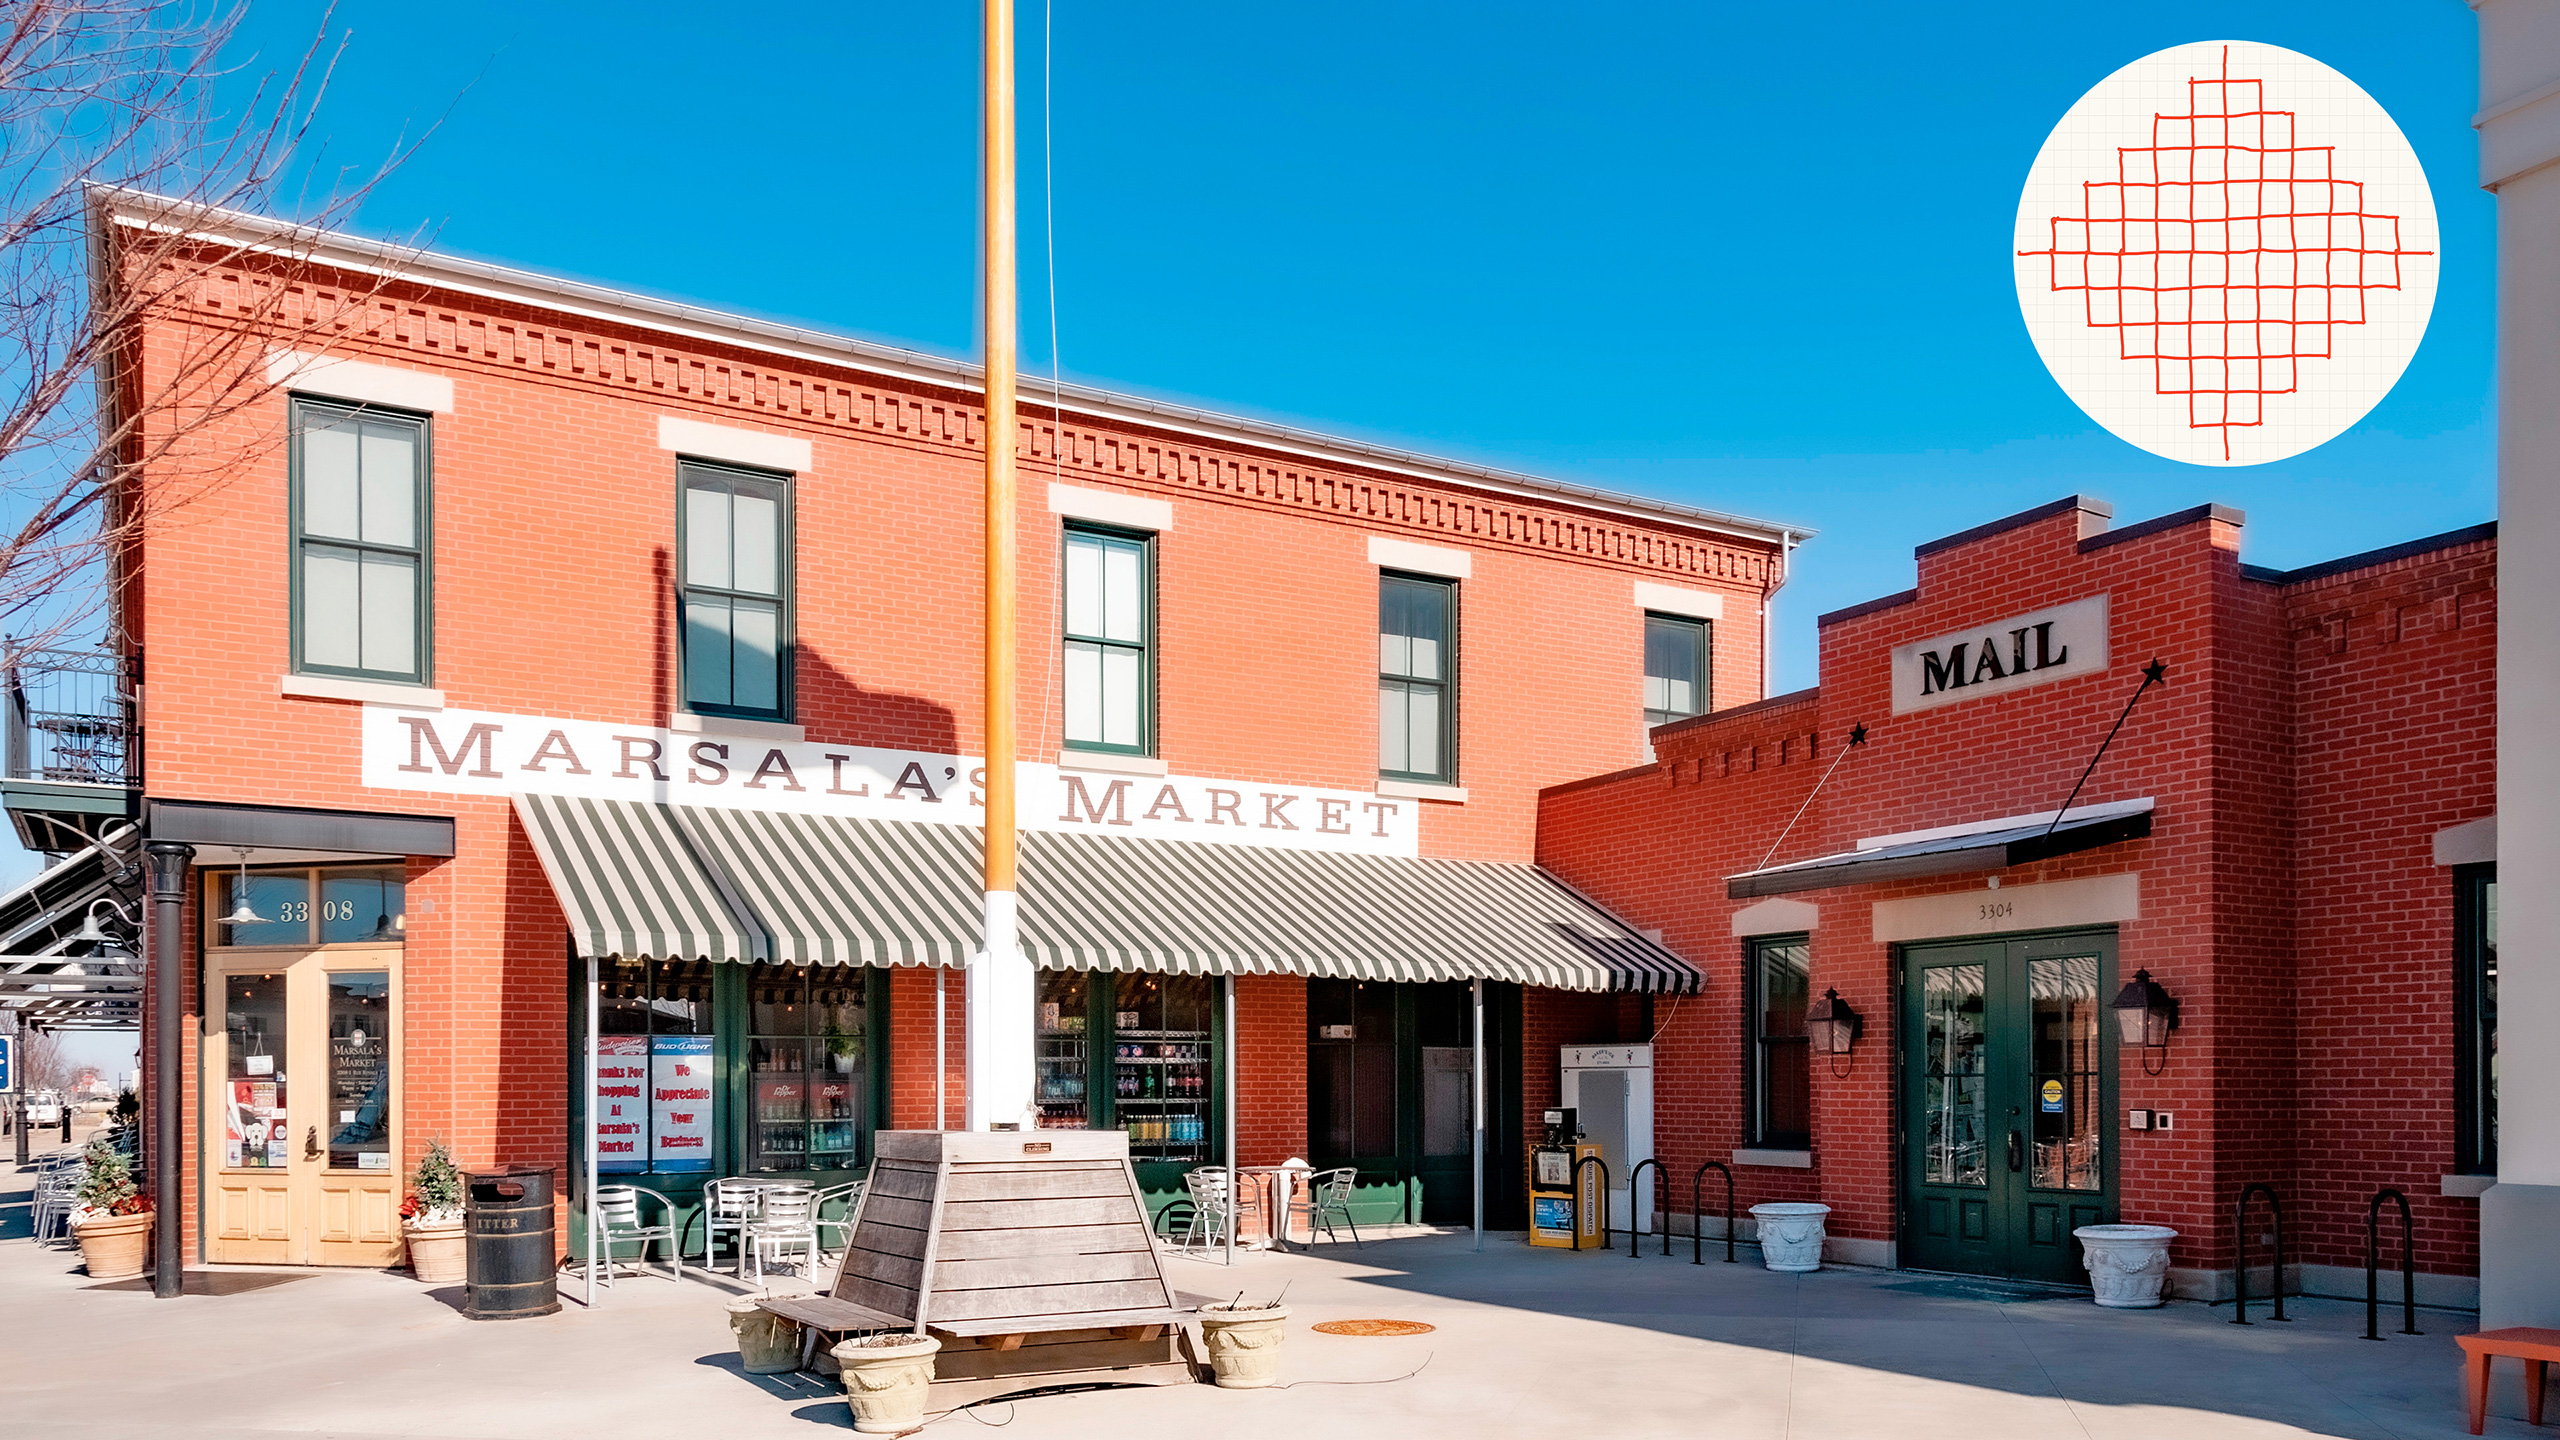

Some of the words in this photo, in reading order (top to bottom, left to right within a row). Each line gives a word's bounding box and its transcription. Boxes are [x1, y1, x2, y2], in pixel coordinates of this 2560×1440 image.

[1919, 621, 2067, 695] MAIL
[1058, 775, 1398, 838] MARKET
[280, 899, 354, 922] 3308
[1979, 901, 2013, 920] 3304
[334, 1044, 383, 1056] MARSALA'S
[597, 1038, 642, 1051] udweiser
[339, 1056, 376, 1067] MARKET
[597, 1066, 626, 1078] hanks
[627, 1066, 645, 1078] For
[674, 1064, 691, 1076] We
[597, 1085, 640, 1098] hopping
[655, 1087, 710, 1101] Appreciate
[773, 1087, 797, 1097] Pepper
[822, 1087, 845, 1097] Pepper
[610, 1104, 622, 1116] At
[670, 1112, 694, 1124] Your
[598, 1140, 634, 1153] Market
[660, 1135, 704, 1148] Business
[477, 1218, 519, 1229] ITTER
